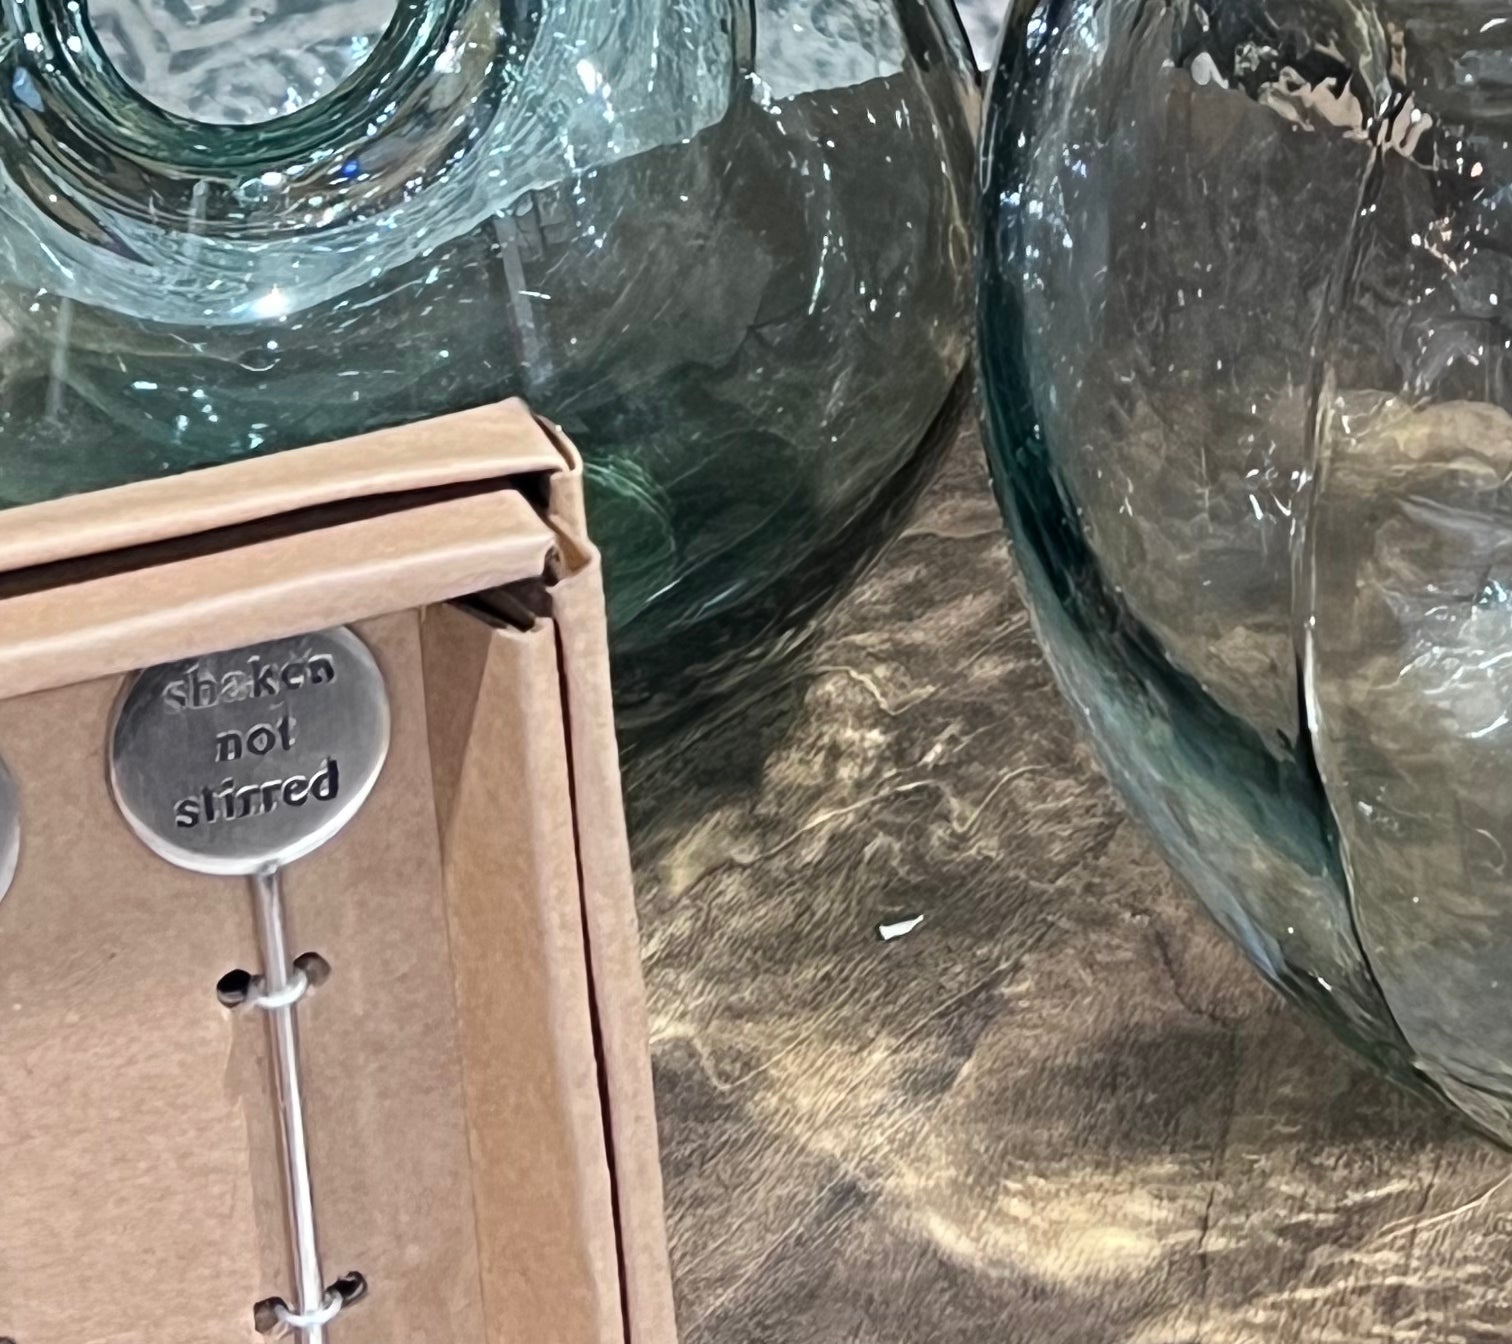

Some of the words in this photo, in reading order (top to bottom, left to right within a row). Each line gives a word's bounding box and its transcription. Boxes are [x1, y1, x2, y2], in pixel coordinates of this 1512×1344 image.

[162, 650, 336, 711] shaken
[214, 712, 297, 762] not
[173, 755, 340, 828] stirred
